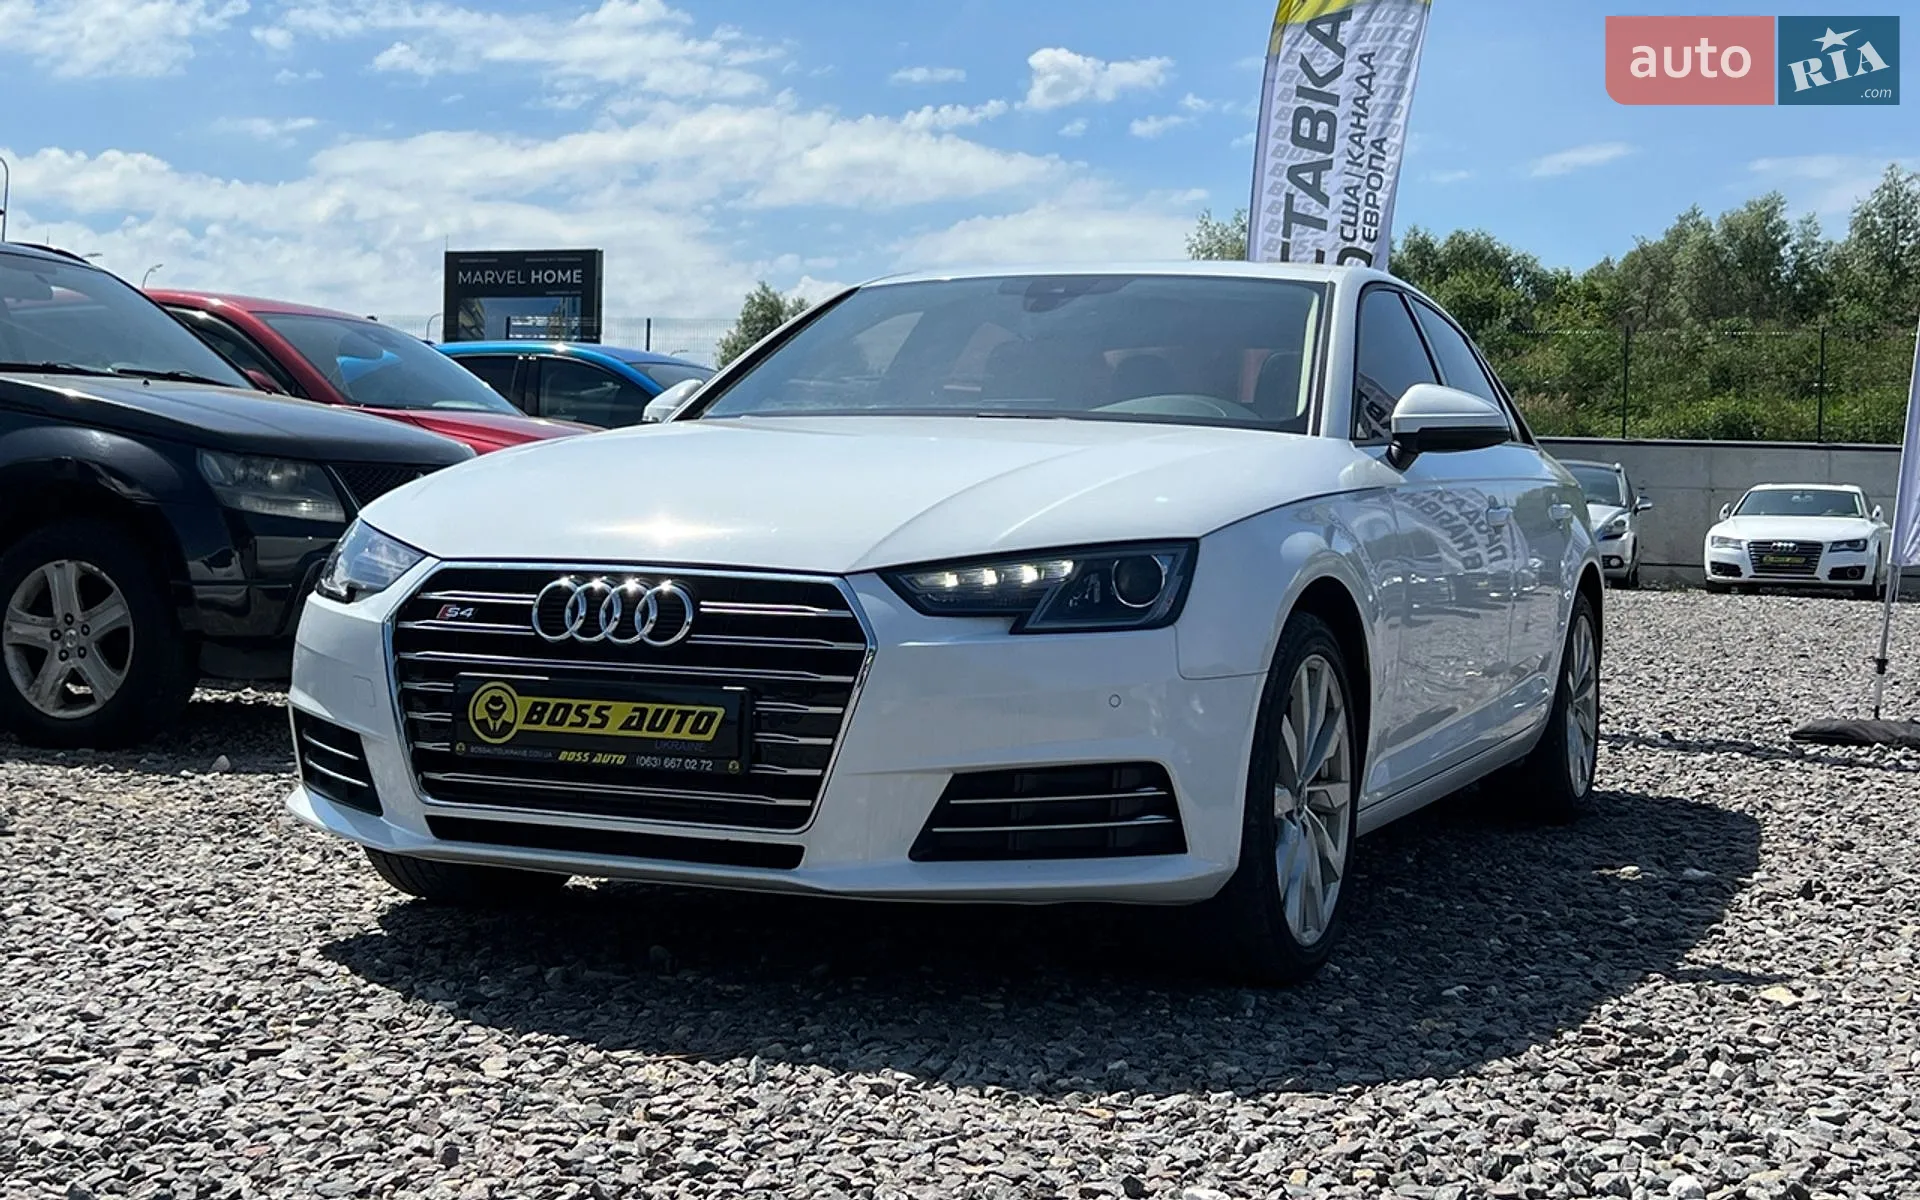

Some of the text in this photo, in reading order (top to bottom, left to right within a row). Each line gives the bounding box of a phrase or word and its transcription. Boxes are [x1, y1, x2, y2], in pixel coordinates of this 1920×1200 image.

[458, 269, 583, 285] MARVEL HOME
[445, 607, 475, 618] S4
[522, 701, 718, 736] BOSS AUTO
[558, 751, 627, 765] BOSS AUTO
[684, 759, 698, 770] 02
[700, 760, 713, 771] 72
